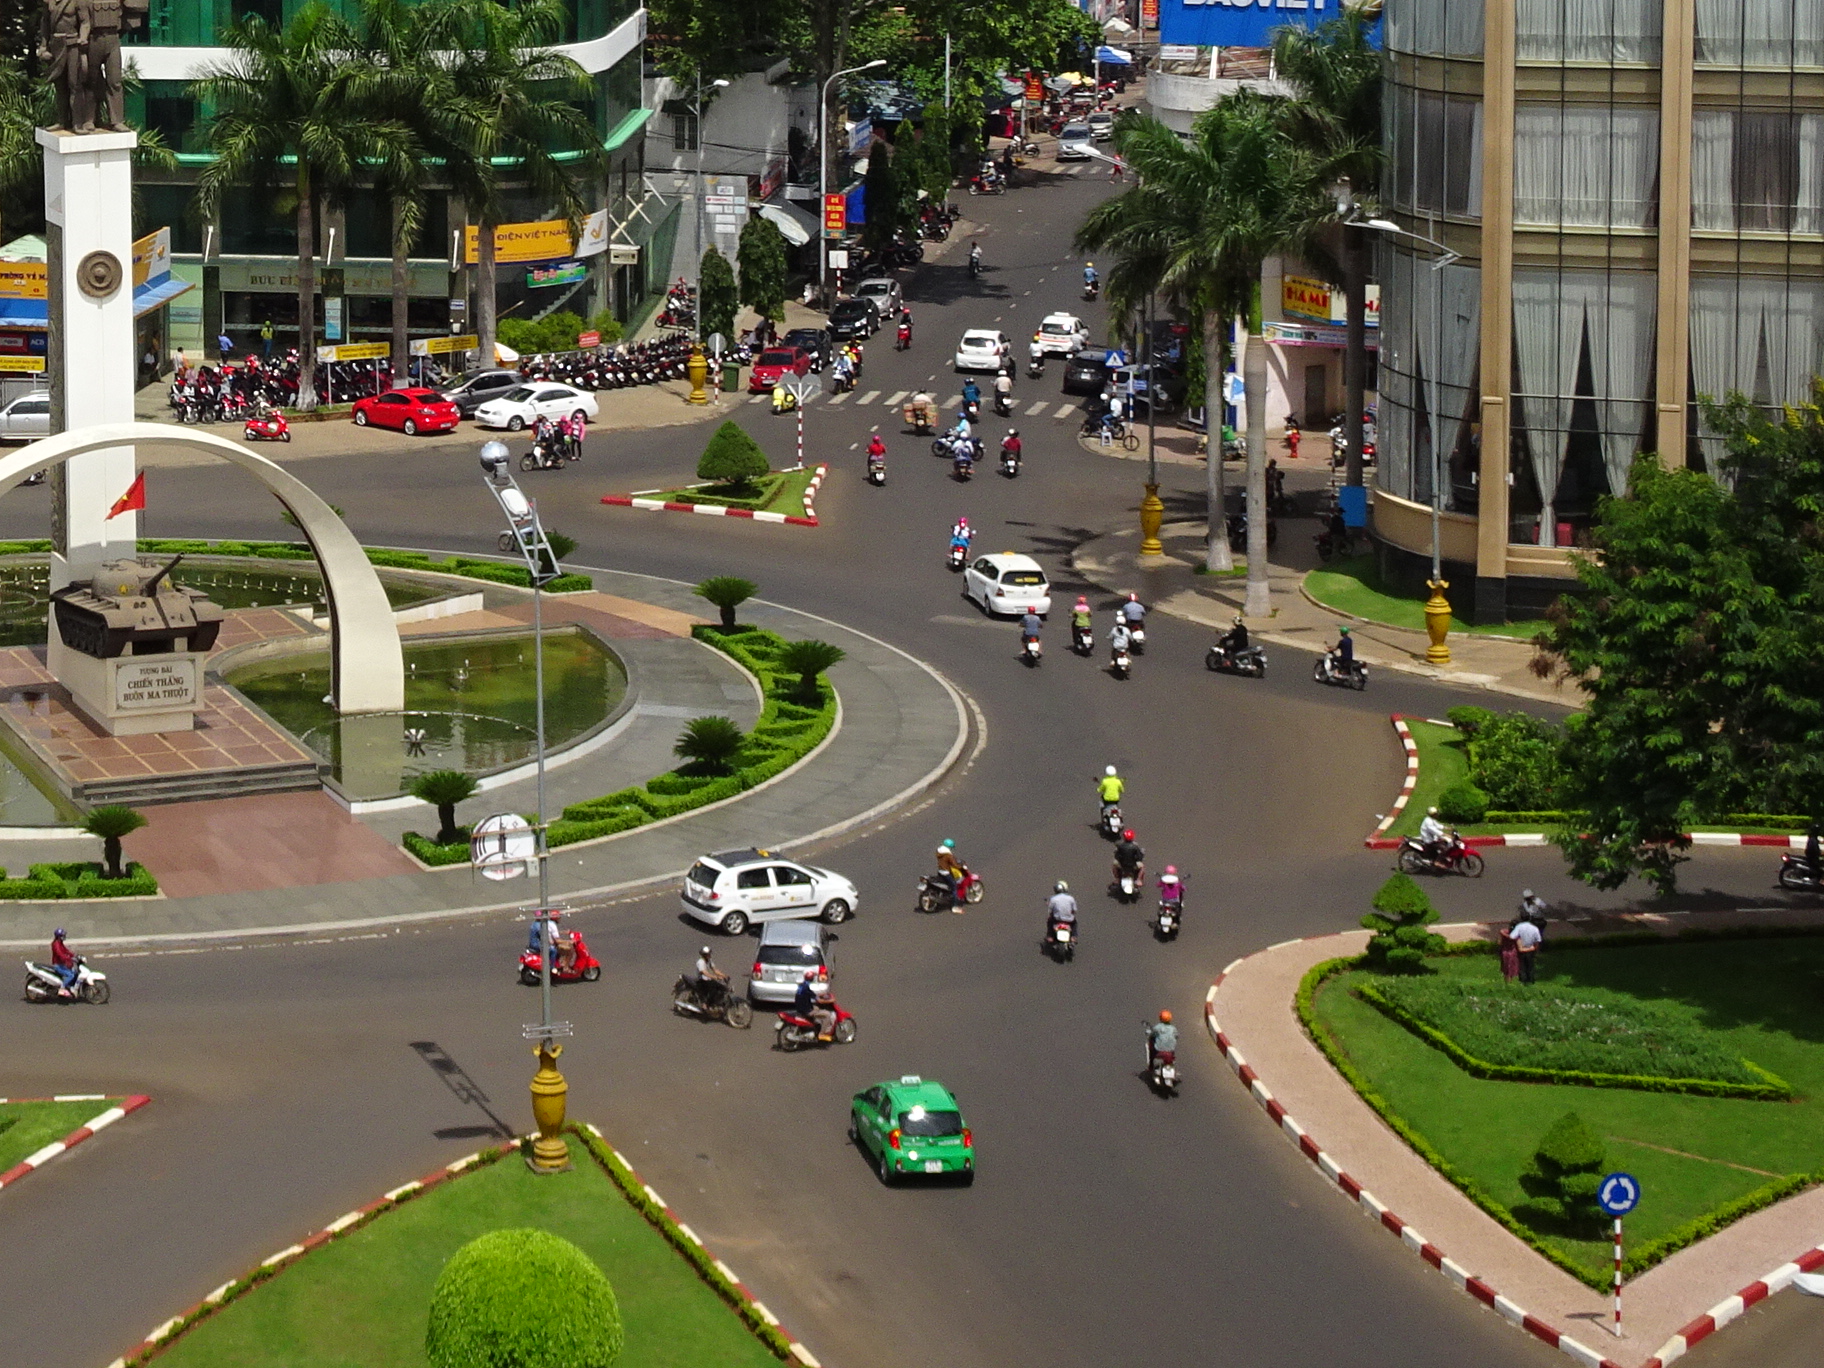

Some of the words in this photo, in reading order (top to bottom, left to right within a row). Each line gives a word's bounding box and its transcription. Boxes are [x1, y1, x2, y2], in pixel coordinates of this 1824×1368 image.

[496, 230, 523, 241] ĐIỆN
[525, 228, 547, 240] VIỆT
[127, 677, 154, 689] CHIẾN
[156, 675, 184, 687] THẮNG
[123, 690, 145, 702] BUÔN
[147, 690, 161, 700] MA
[162, 687, 189, 700] THUỘT
